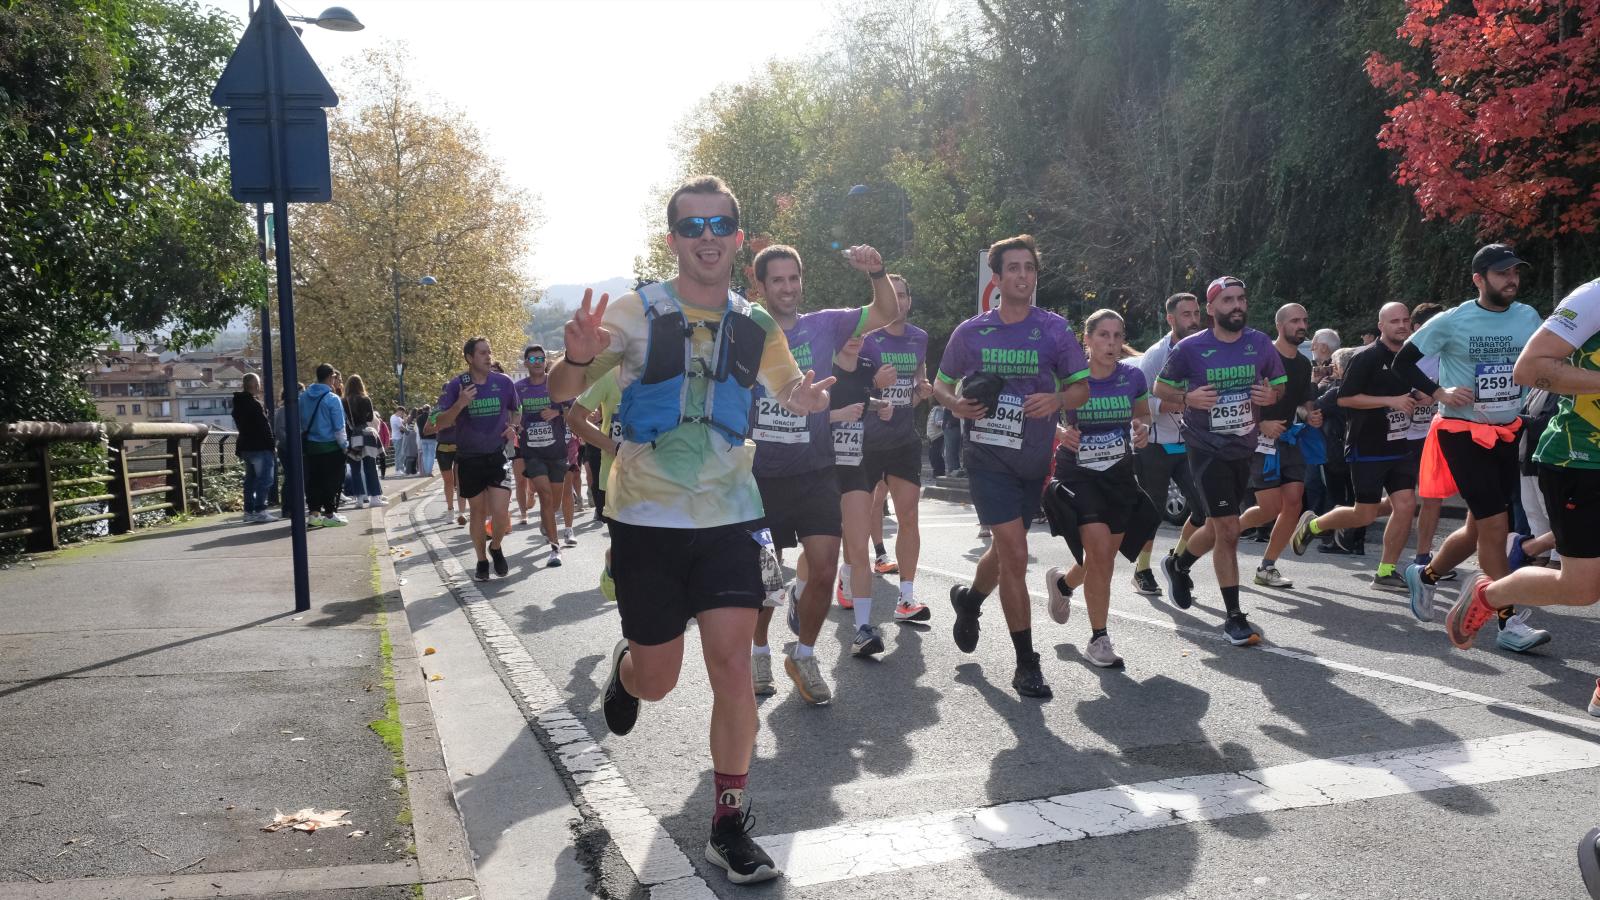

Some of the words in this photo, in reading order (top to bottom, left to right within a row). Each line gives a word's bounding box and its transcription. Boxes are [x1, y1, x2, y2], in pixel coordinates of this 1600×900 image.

[880, 352, 917, 364] BEHOBIA
[982, 348, 1039, 365] BEHOBIA
[1206, 364, 1256, 381] BEHOBIA
[1480, 376, 1518, 390] 2591
[998, 394, 1022, 406] oma
[1076, 395, 1131, 411] EHOBIA
[1212, 402, 1251, 419] 26529
[528, 427, 552, 436] 28562
